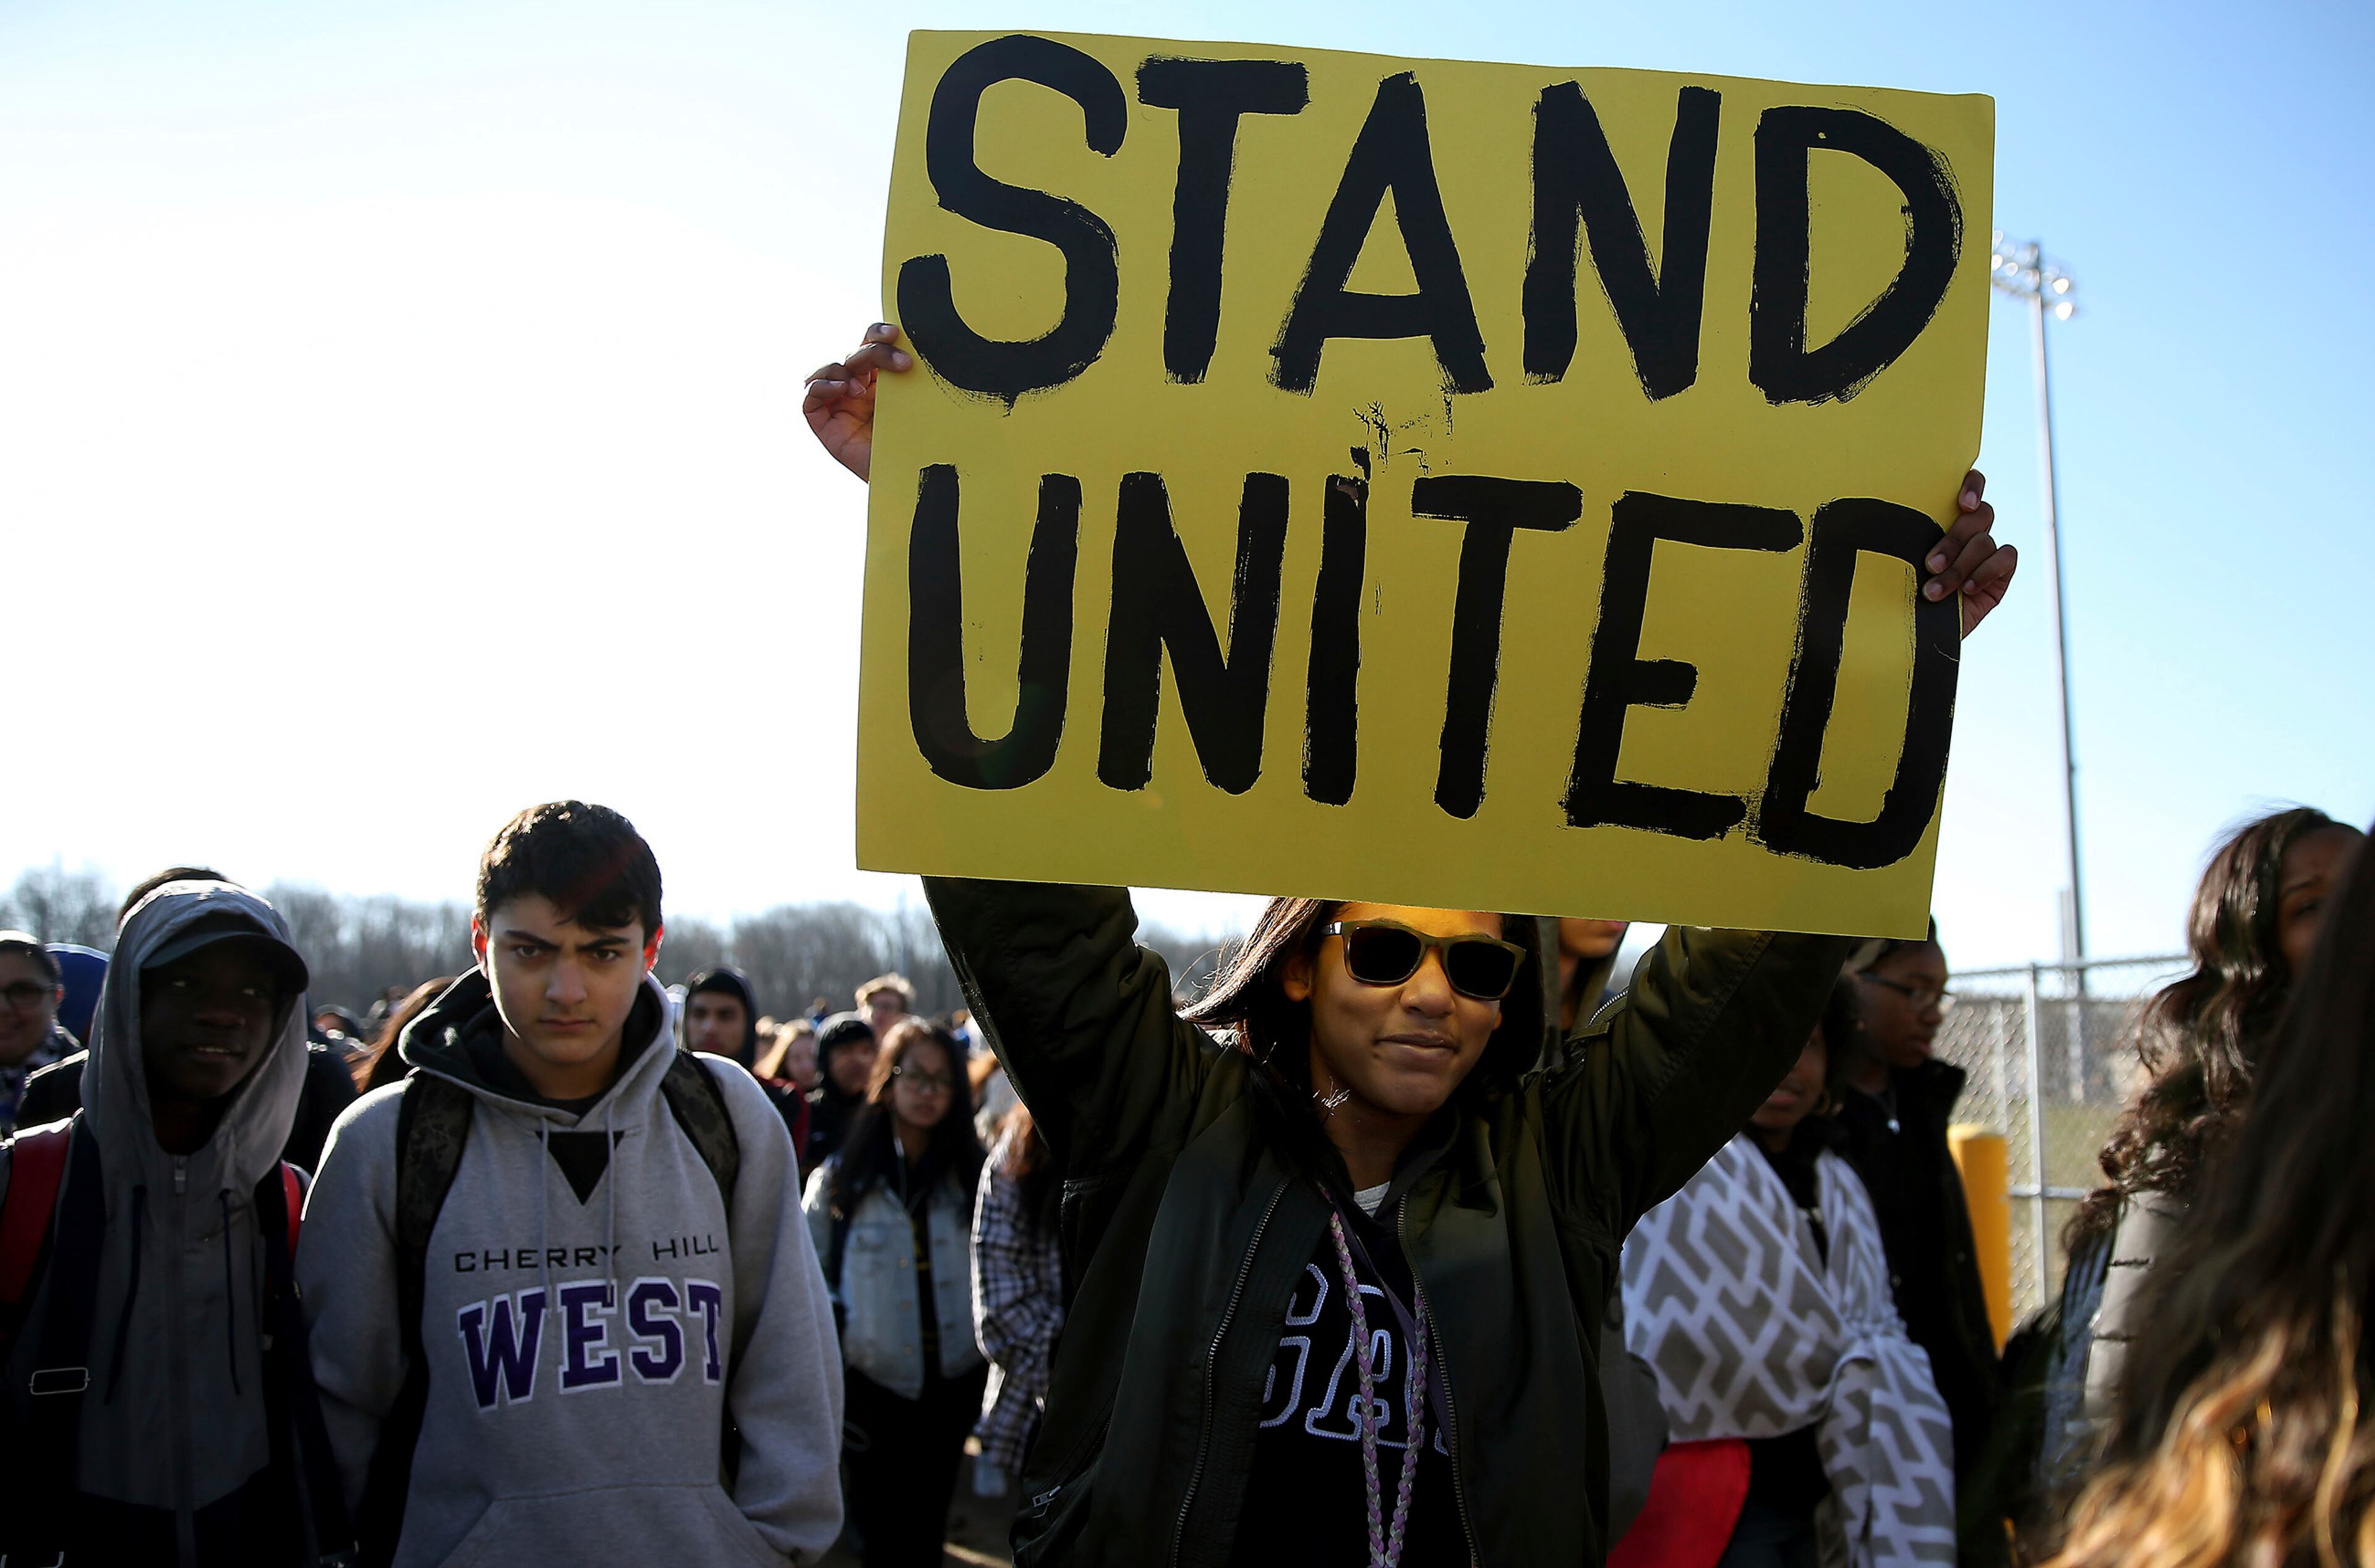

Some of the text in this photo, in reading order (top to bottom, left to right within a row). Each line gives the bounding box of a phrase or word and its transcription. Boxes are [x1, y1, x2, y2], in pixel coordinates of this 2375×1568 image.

[897, 34, 1963, 409] STAND
[908, 462, 1961, 869] UNITED
[455, 1235, 719, 1272] CHERRY HILL
[456, 1277, 721, 1413] WEST
